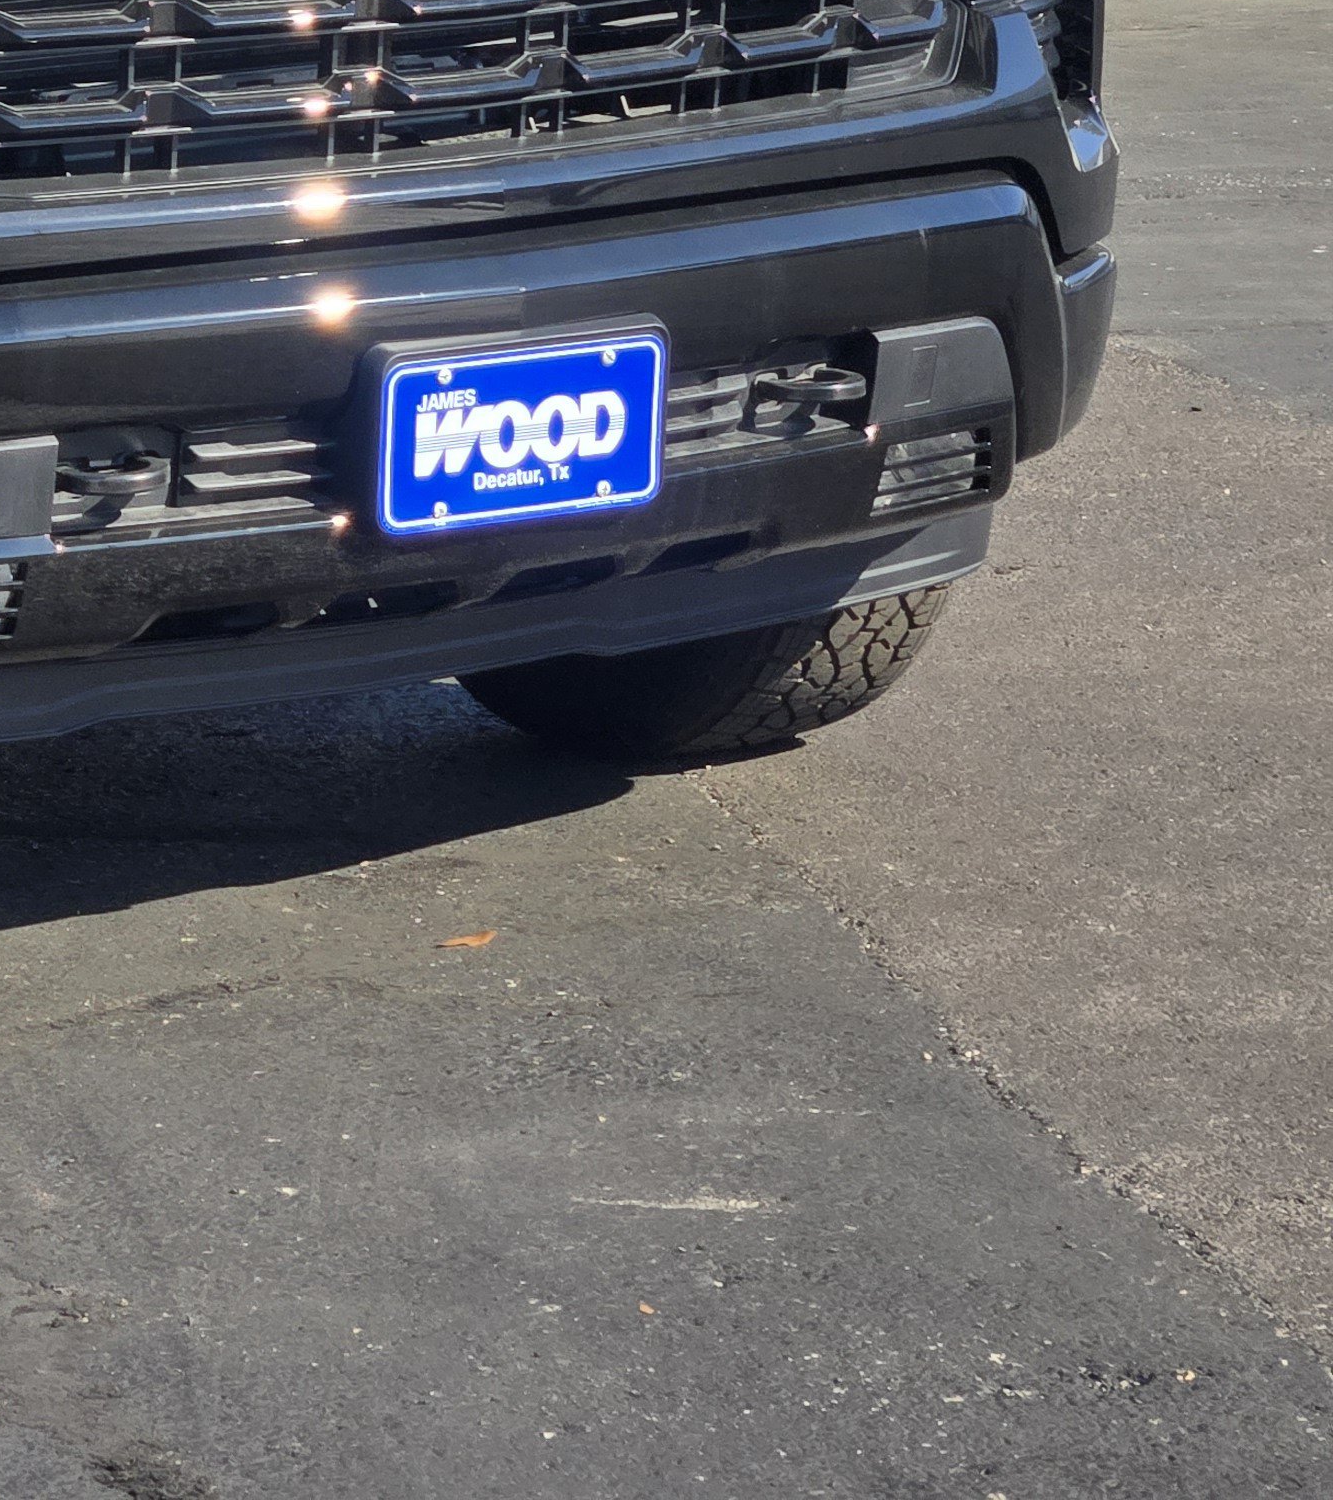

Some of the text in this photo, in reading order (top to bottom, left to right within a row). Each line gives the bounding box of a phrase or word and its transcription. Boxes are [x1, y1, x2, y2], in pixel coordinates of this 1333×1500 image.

[416, 388, 477, 412] JAMES
[413, 390, 626, 479] WOOD
[473, 469, 545, 492] Decatur,
